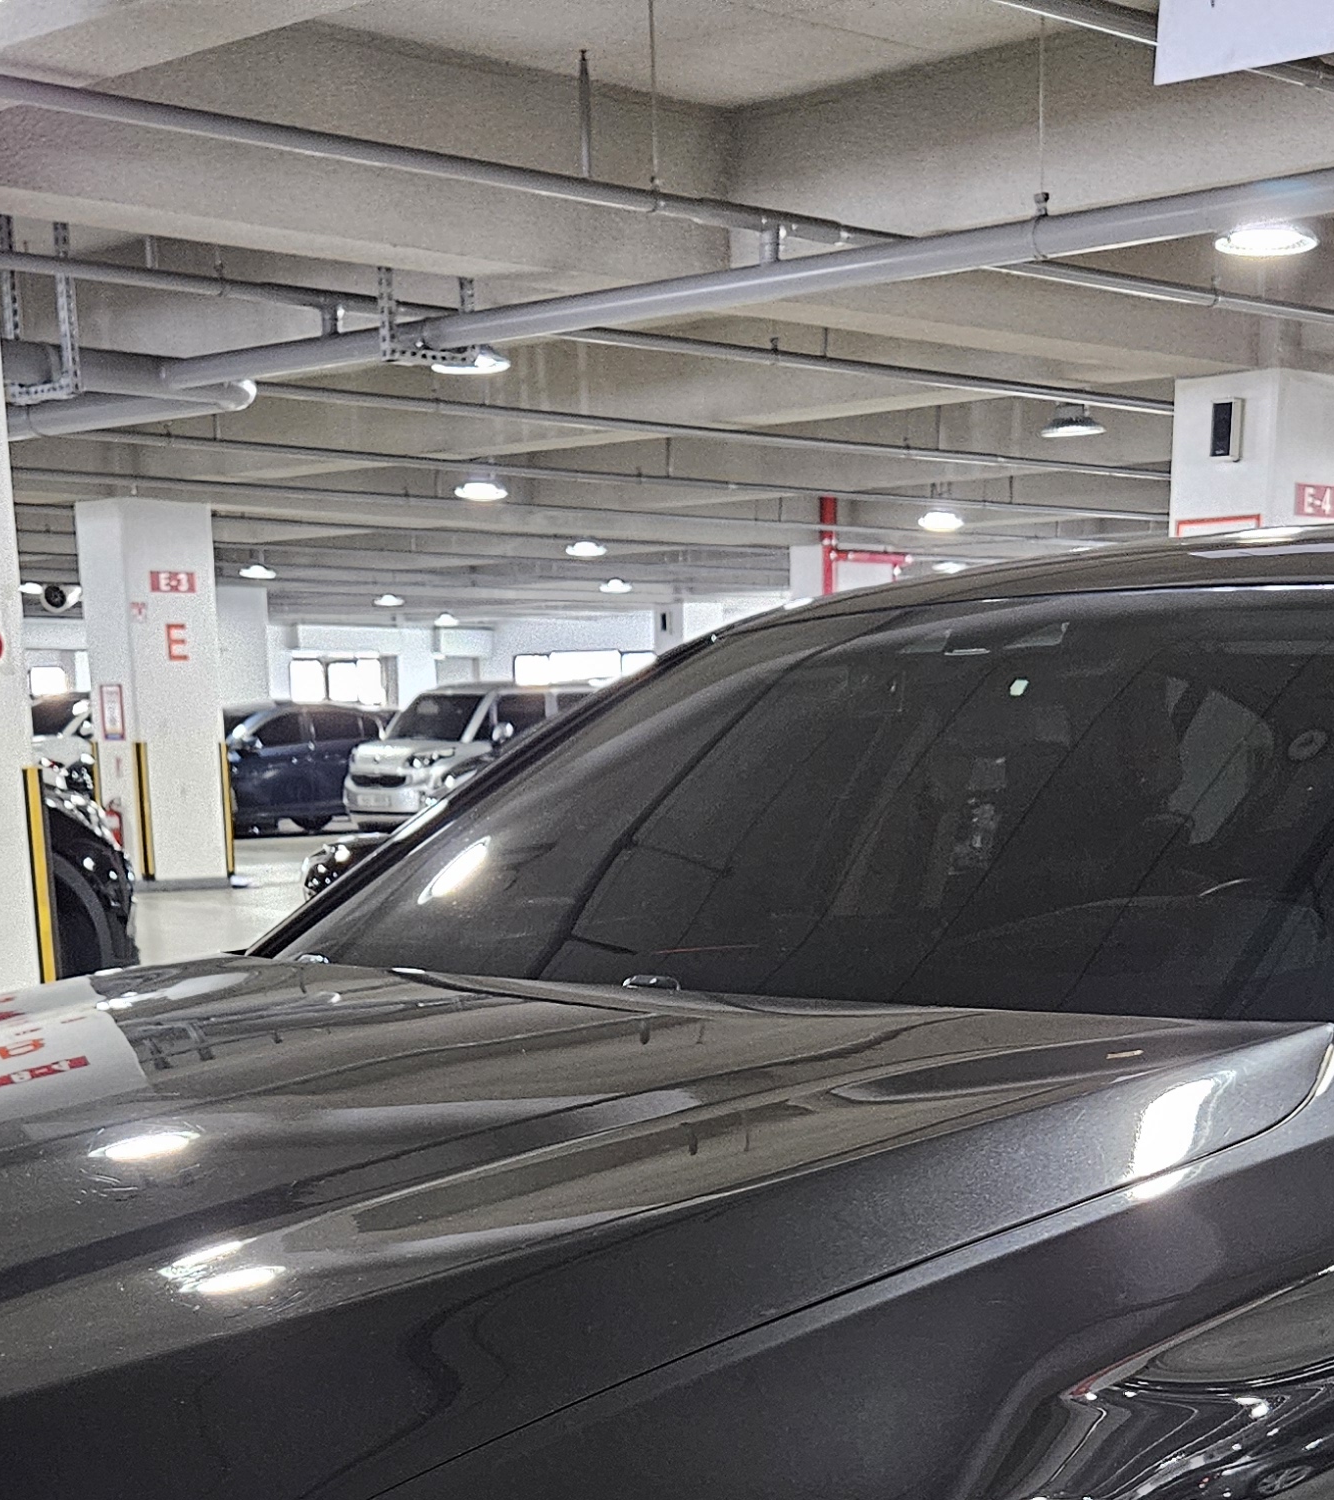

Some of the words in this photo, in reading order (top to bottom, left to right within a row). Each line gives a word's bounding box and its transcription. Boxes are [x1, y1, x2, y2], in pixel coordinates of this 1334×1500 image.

[1303, 485, 1332, 515] E-4
[158, 572, 189, 592] E-3
[165, 623, 189, 661] E
